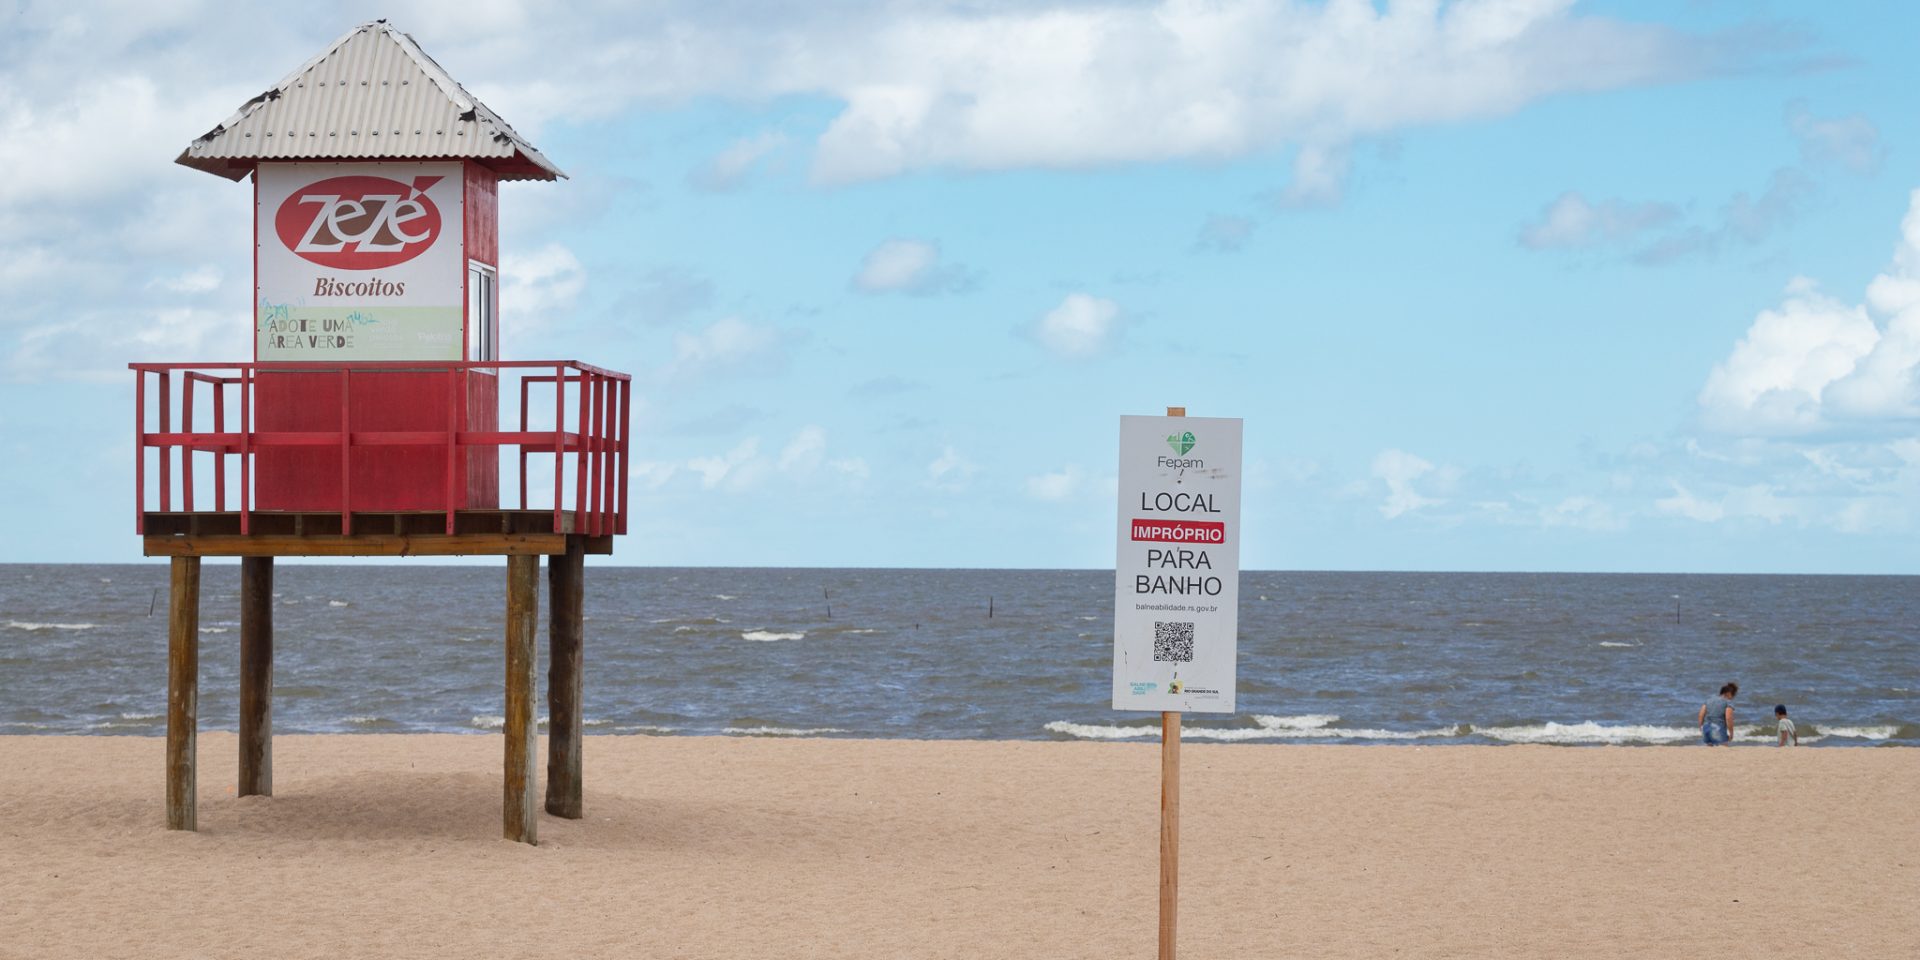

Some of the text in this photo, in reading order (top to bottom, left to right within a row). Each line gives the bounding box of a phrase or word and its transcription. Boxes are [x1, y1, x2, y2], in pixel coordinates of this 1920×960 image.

[313, 277, 405, 297] Biscoitos
[269, 319, 354, 333] ADOTE UMA
[268, 333, 355, 349] ÁREA VERDE
[1157, 456, 1204, 470] Fepam
[1141, 492, 1221, 513] LOCAL
[1133, 523, 1222, 541] IMPRÓPRIO
[1147, 549, 1212, 570] PARA
[1135, 575, 1222, 596] BANHO
[1135, 603, 1218, 613] balneabilidade.rs.gov.br
